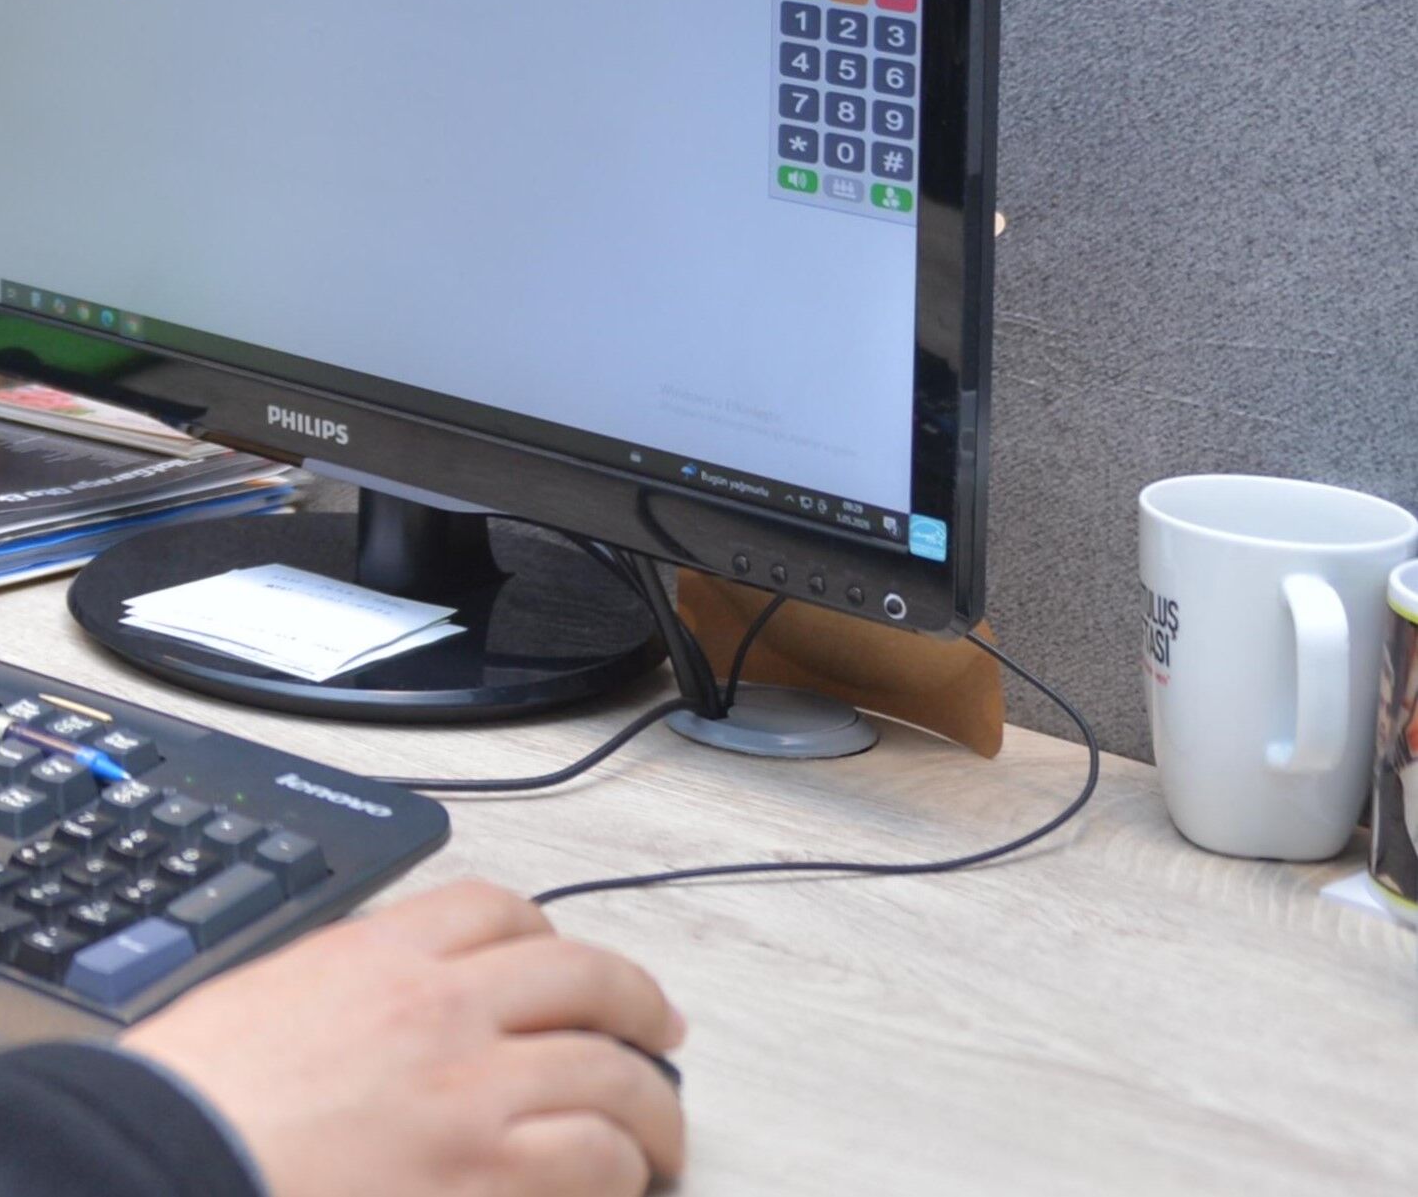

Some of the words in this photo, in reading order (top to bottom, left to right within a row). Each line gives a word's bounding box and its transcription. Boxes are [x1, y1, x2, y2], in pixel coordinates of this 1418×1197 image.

[795, 11, 807, 31] 1
[839, 18, 857, 39] 2
[887, 26, 905, 47] 3
[791, 52, 809, 72] 4
[838, 59, 856, 80] 5
[886, 68, 904, 89] 6
[791, 92, 809, 113] 7
[837, 101, 855, 122] 8
[885, 110, 903, 131] 9
[836, 142, 854, 163] 0
[883, 151, 904, 172] #
[267, 404, 349, 445] PHILIPS
